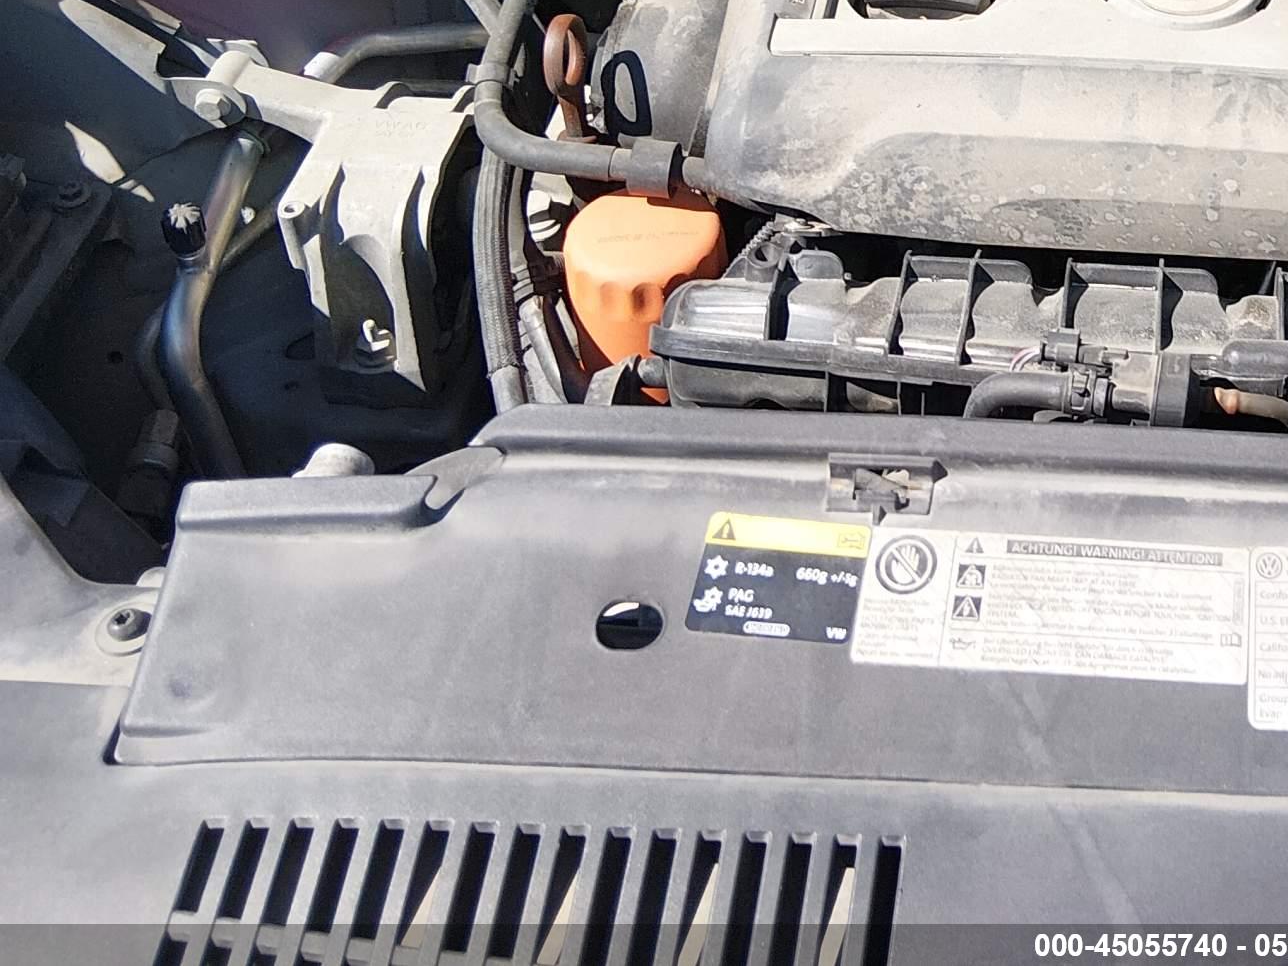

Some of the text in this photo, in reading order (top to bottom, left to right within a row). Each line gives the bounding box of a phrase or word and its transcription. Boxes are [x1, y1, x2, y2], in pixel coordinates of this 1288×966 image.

[1012, 541, 1219, 564] ACHTUNG! WARNING! ATTENTION!
[735, 561, 774, 577] R-134a
[728, 587, 754, 603] PAG
[725, 604, 745, 617] SAE
[826, 626, 847, 640] VW
[1257, 668, 1270, 679] No
